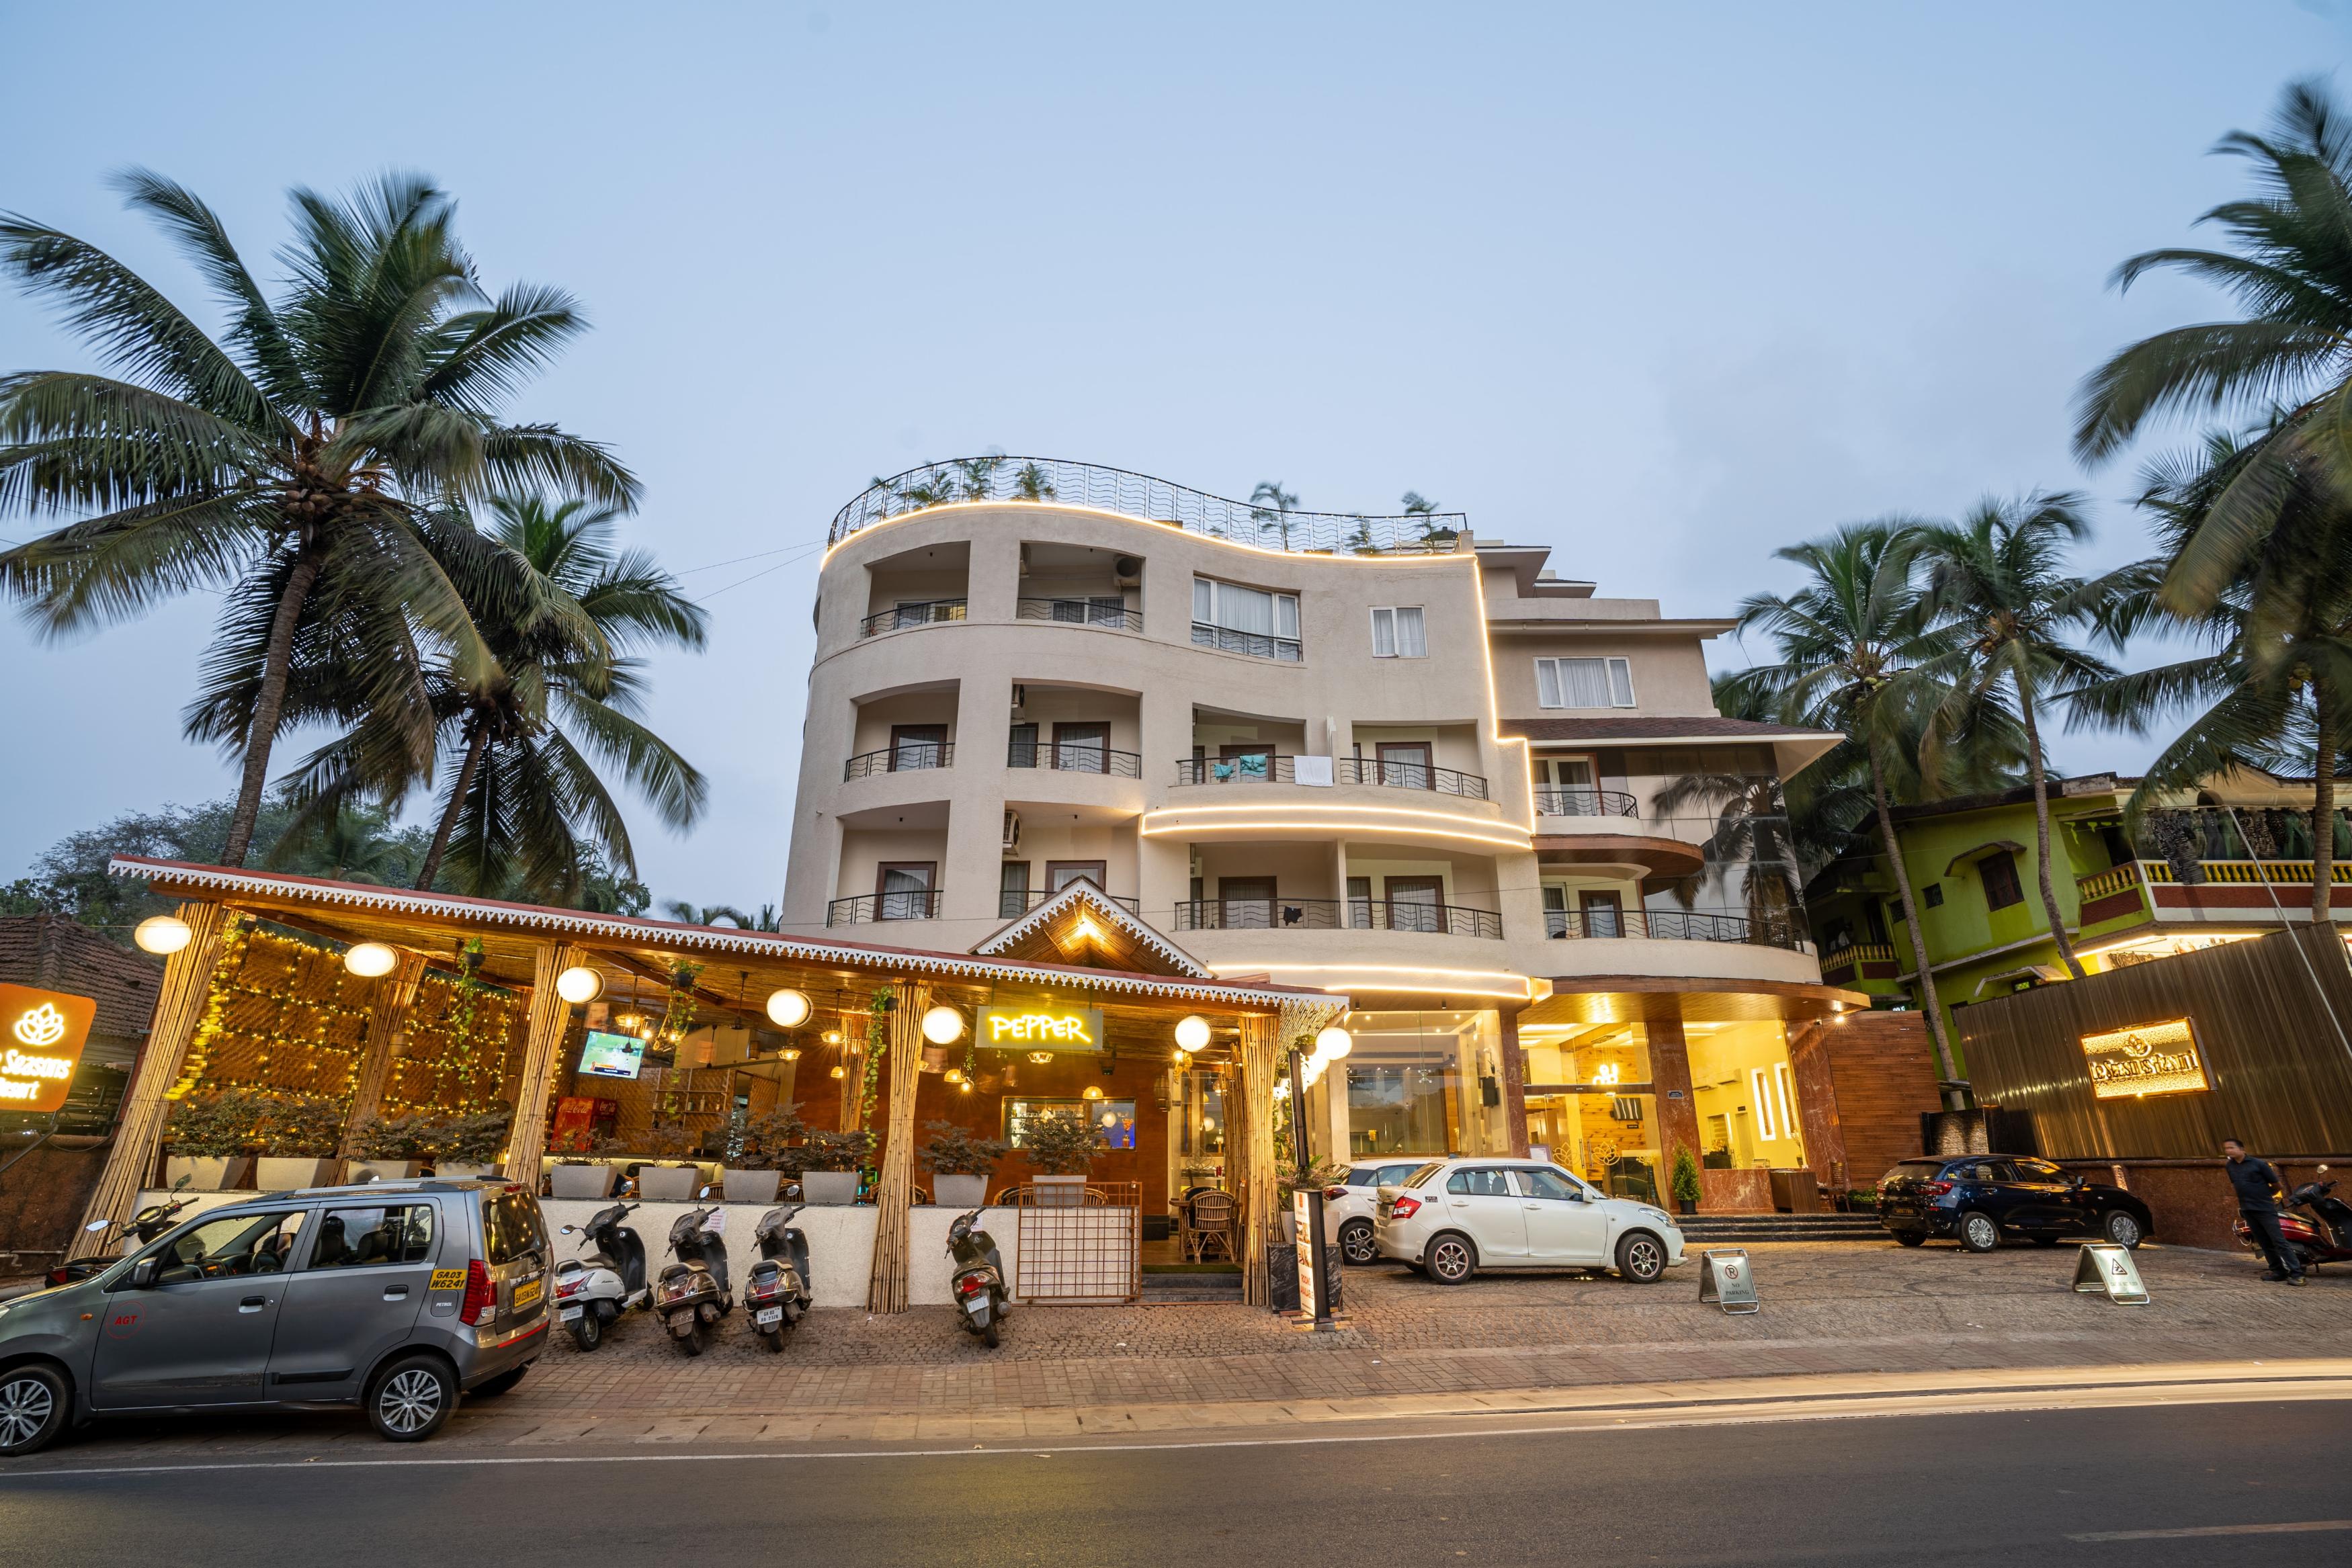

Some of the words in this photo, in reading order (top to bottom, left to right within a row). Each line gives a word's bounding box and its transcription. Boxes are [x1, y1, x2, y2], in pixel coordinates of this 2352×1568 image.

[989, 1014, 1092, 1043] PEPPER
[2, 1049, 72, 1079] Seasons
[114, 1314, 138, 1325] AGT
